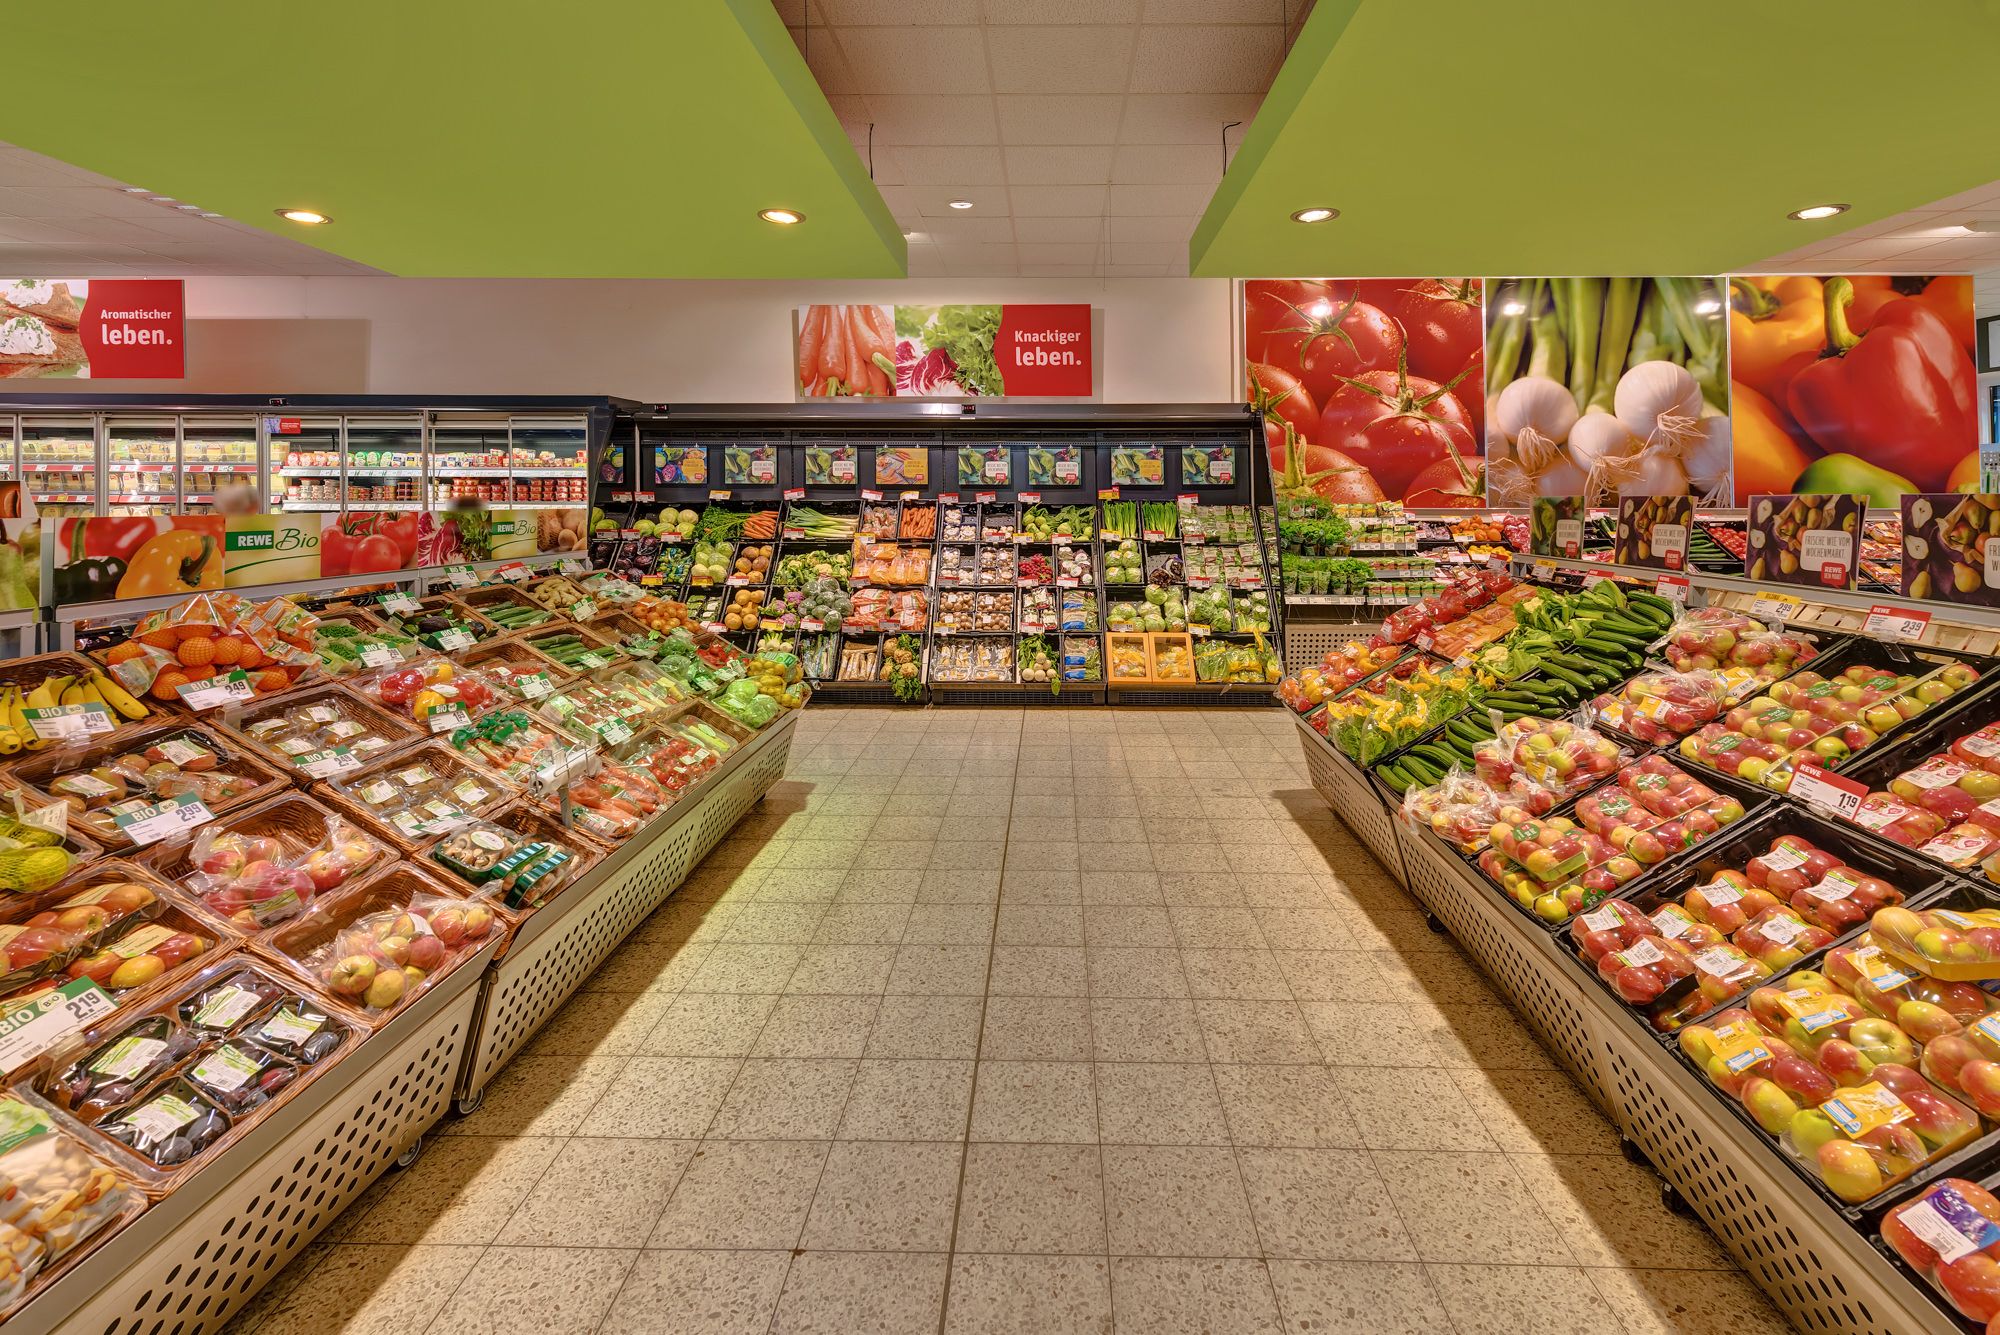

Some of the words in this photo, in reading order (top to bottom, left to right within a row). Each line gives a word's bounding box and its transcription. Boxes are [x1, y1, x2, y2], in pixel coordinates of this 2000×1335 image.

[101, 309, 172, 319] Aromatischer
[102, 323, 173, 345] leben.
[1014, 330, 1081, 345] Knackiger
[1015, 346, 1082, 366] leben.
[497, 523, 515, 533] REWE
[515, 520, 537, 536] Bio
[237, 534, 273, 547] REWE
[275, 528, 319, 551] Bio
[1804, 535, 1825, 546] FRISCHE
[1826, 536, 1837, 547] WIE
[1824, 566, 1843, 574] REWE
[1776, 602, 1793, 614] 2.99
[1872, 607, 1891, 615] REWE
[1901, 620, 1923, 634] 2.39
[190, 680, 211, 692] BIO
[225, 681, 247, 696] 2.49
[37, 707, 63, 719] BIO
[80, 713, 105, 728] 2.49
[303, 753, 323, 763] BIO
[1799, 763, 1823, 778] REWE
[1839, 792, 1859, 809] 1.19
[130, 807, 158, 822] BIO
[175, 803, 202, 823] 2.99
[42, 995, 60, 1008] BIO
[65, 991, 101, 1020] 2.19
[0, 1008, 35, 1036] BIO
